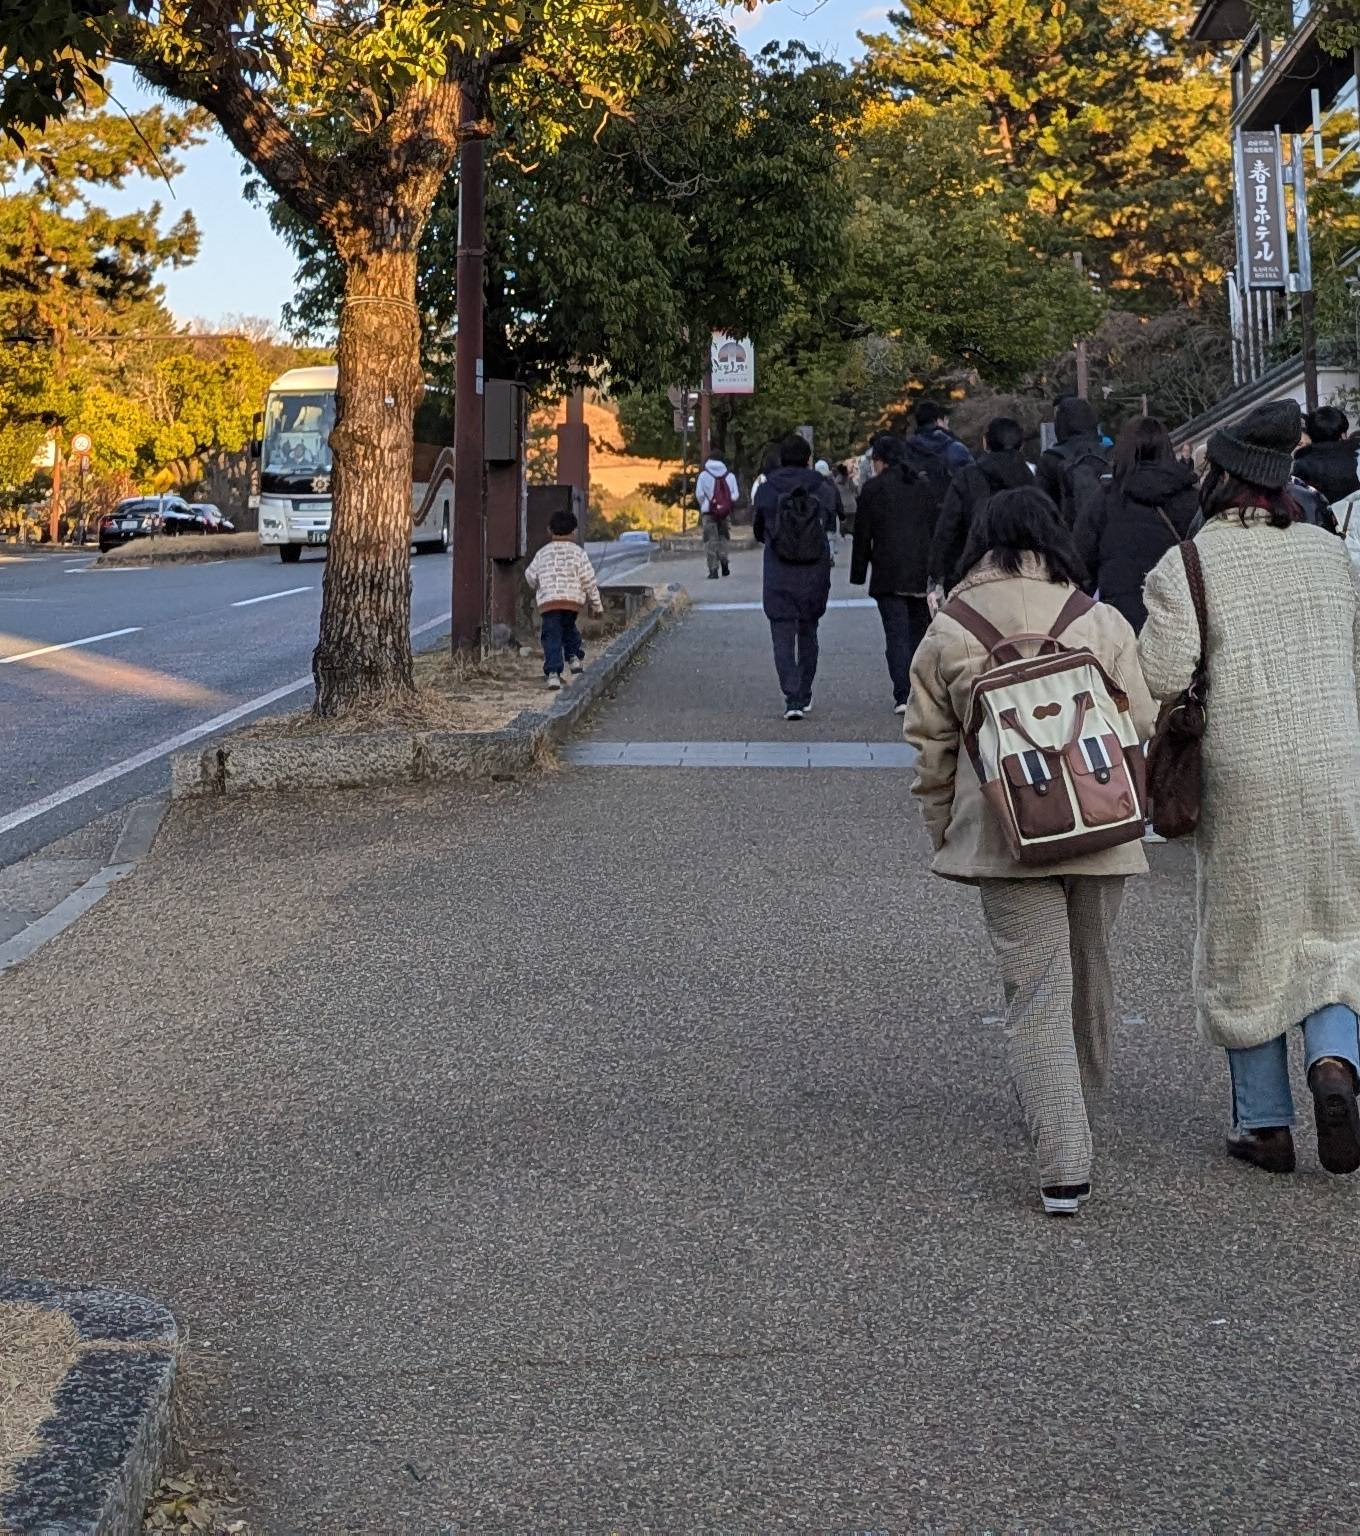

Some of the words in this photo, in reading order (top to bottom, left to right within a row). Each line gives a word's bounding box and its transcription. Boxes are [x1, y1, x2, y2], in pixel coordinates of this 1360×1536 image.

[1248, 159, 1274, 262] 春日ホテル
